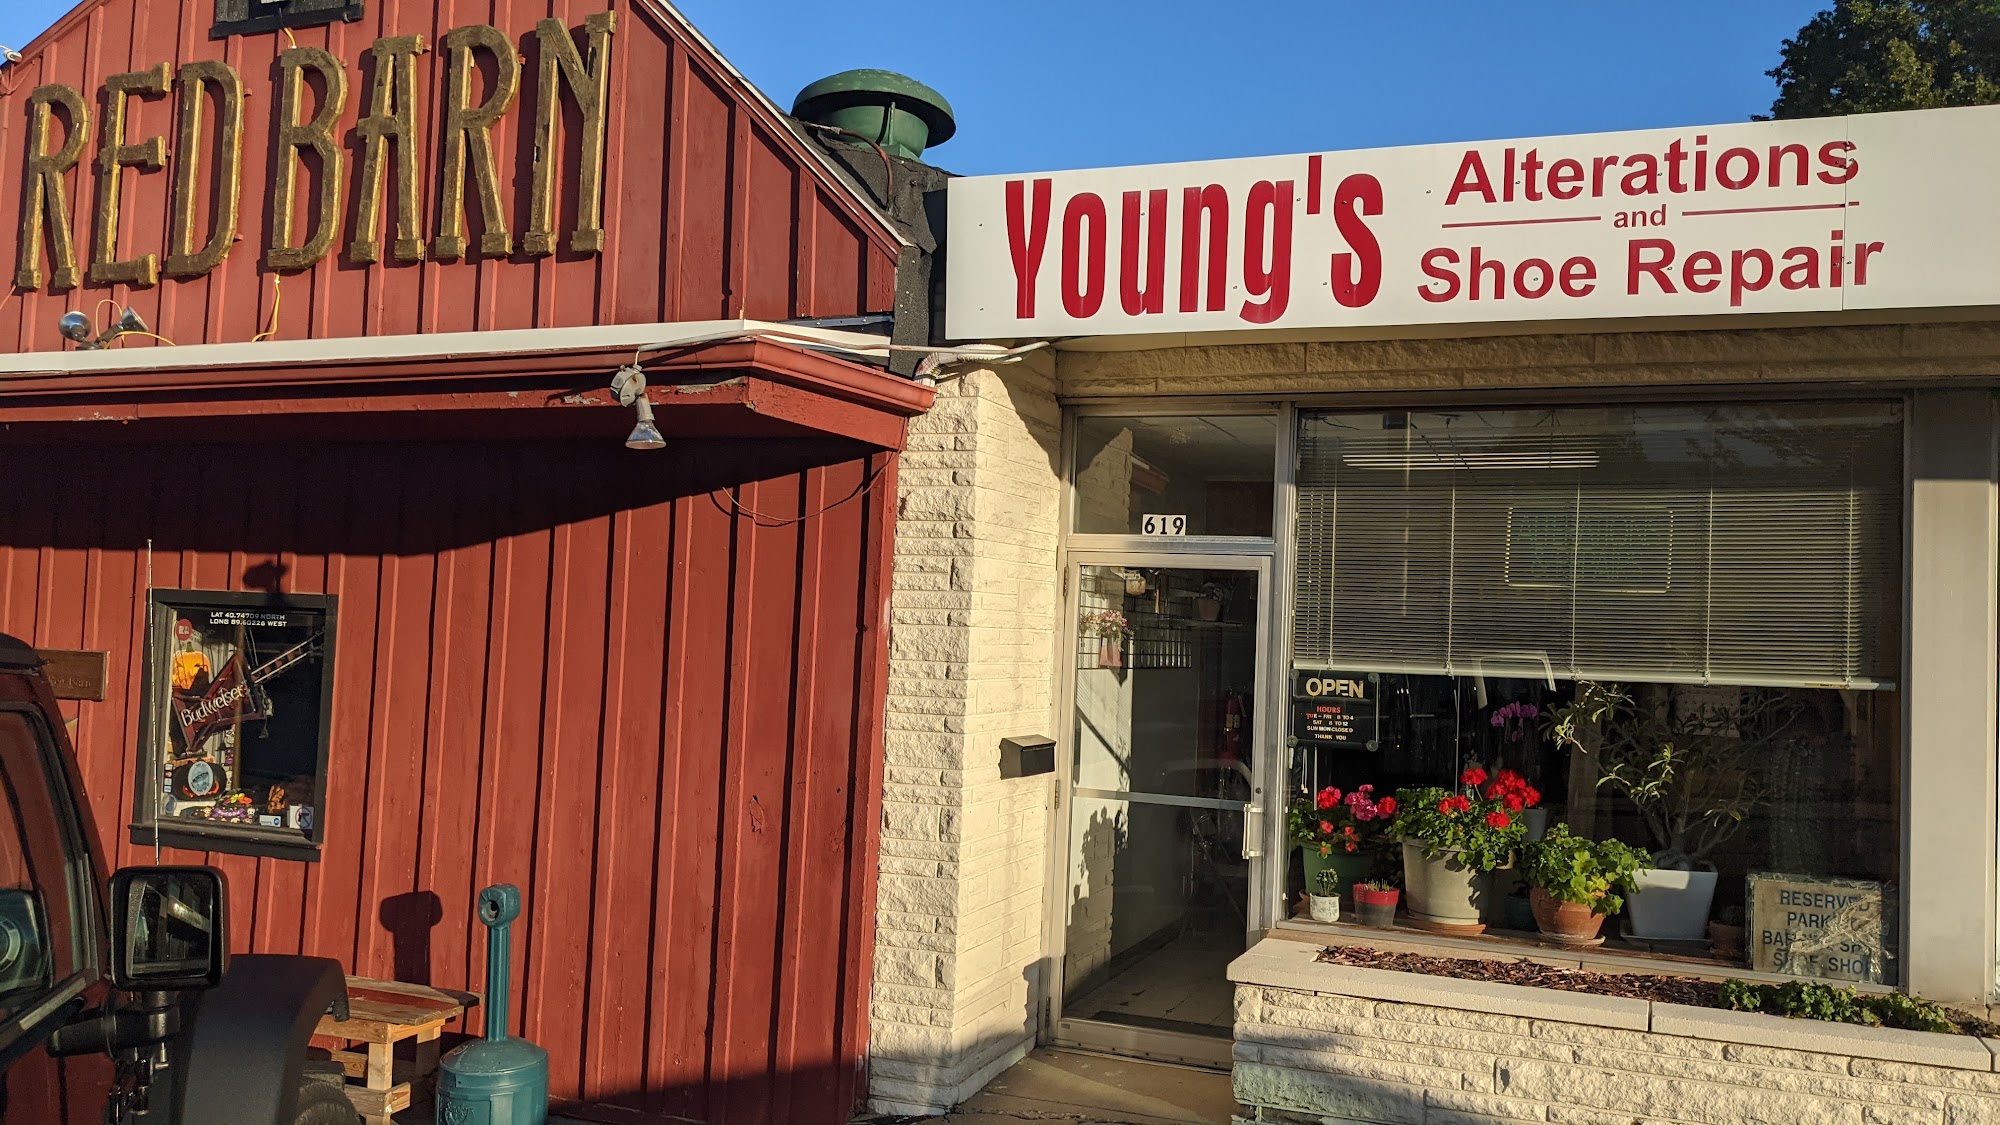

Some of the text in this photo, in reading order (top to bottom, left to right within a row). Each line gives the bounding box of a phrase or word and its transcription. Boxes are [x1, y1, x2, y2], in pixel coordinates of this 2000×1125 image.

[18, 10, 617, 289] RED BARN
[1444, 134, 1860, 206] Alterations
[1005, 154, 1384, 324] Young's
[1613, 203, 1667, 228] and
[1417, 229, 1885, 307] Shoe Repair
[1144, 516, 1184, 535] 619
[181, 684, 246, 727] Budweiser
[1306, 677, 1364, 699] OPEN
